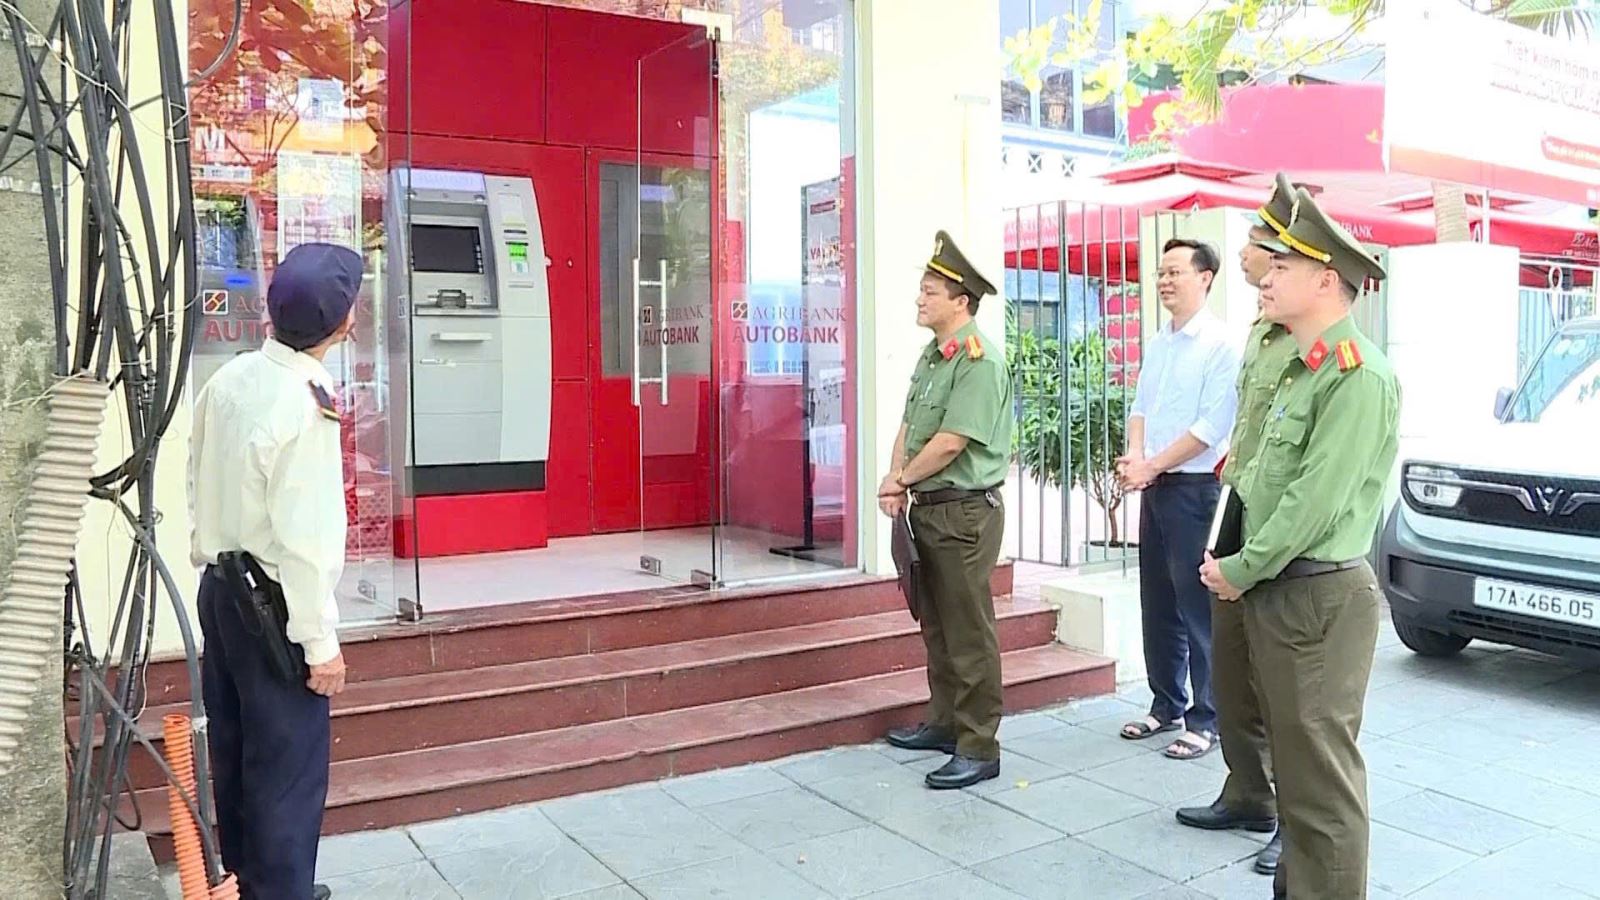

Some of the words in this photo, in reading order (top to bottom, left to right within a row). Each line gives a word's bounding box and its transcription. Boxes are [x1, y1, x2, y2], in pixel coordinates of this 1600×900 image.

[652, 303, 704, 323] GRIBANK
[752, 306, 847, 322] AGRIBANK
[643, 325, 699, 345] AUTOBANK
[732, 325, 839, 344] AUTOBANK
